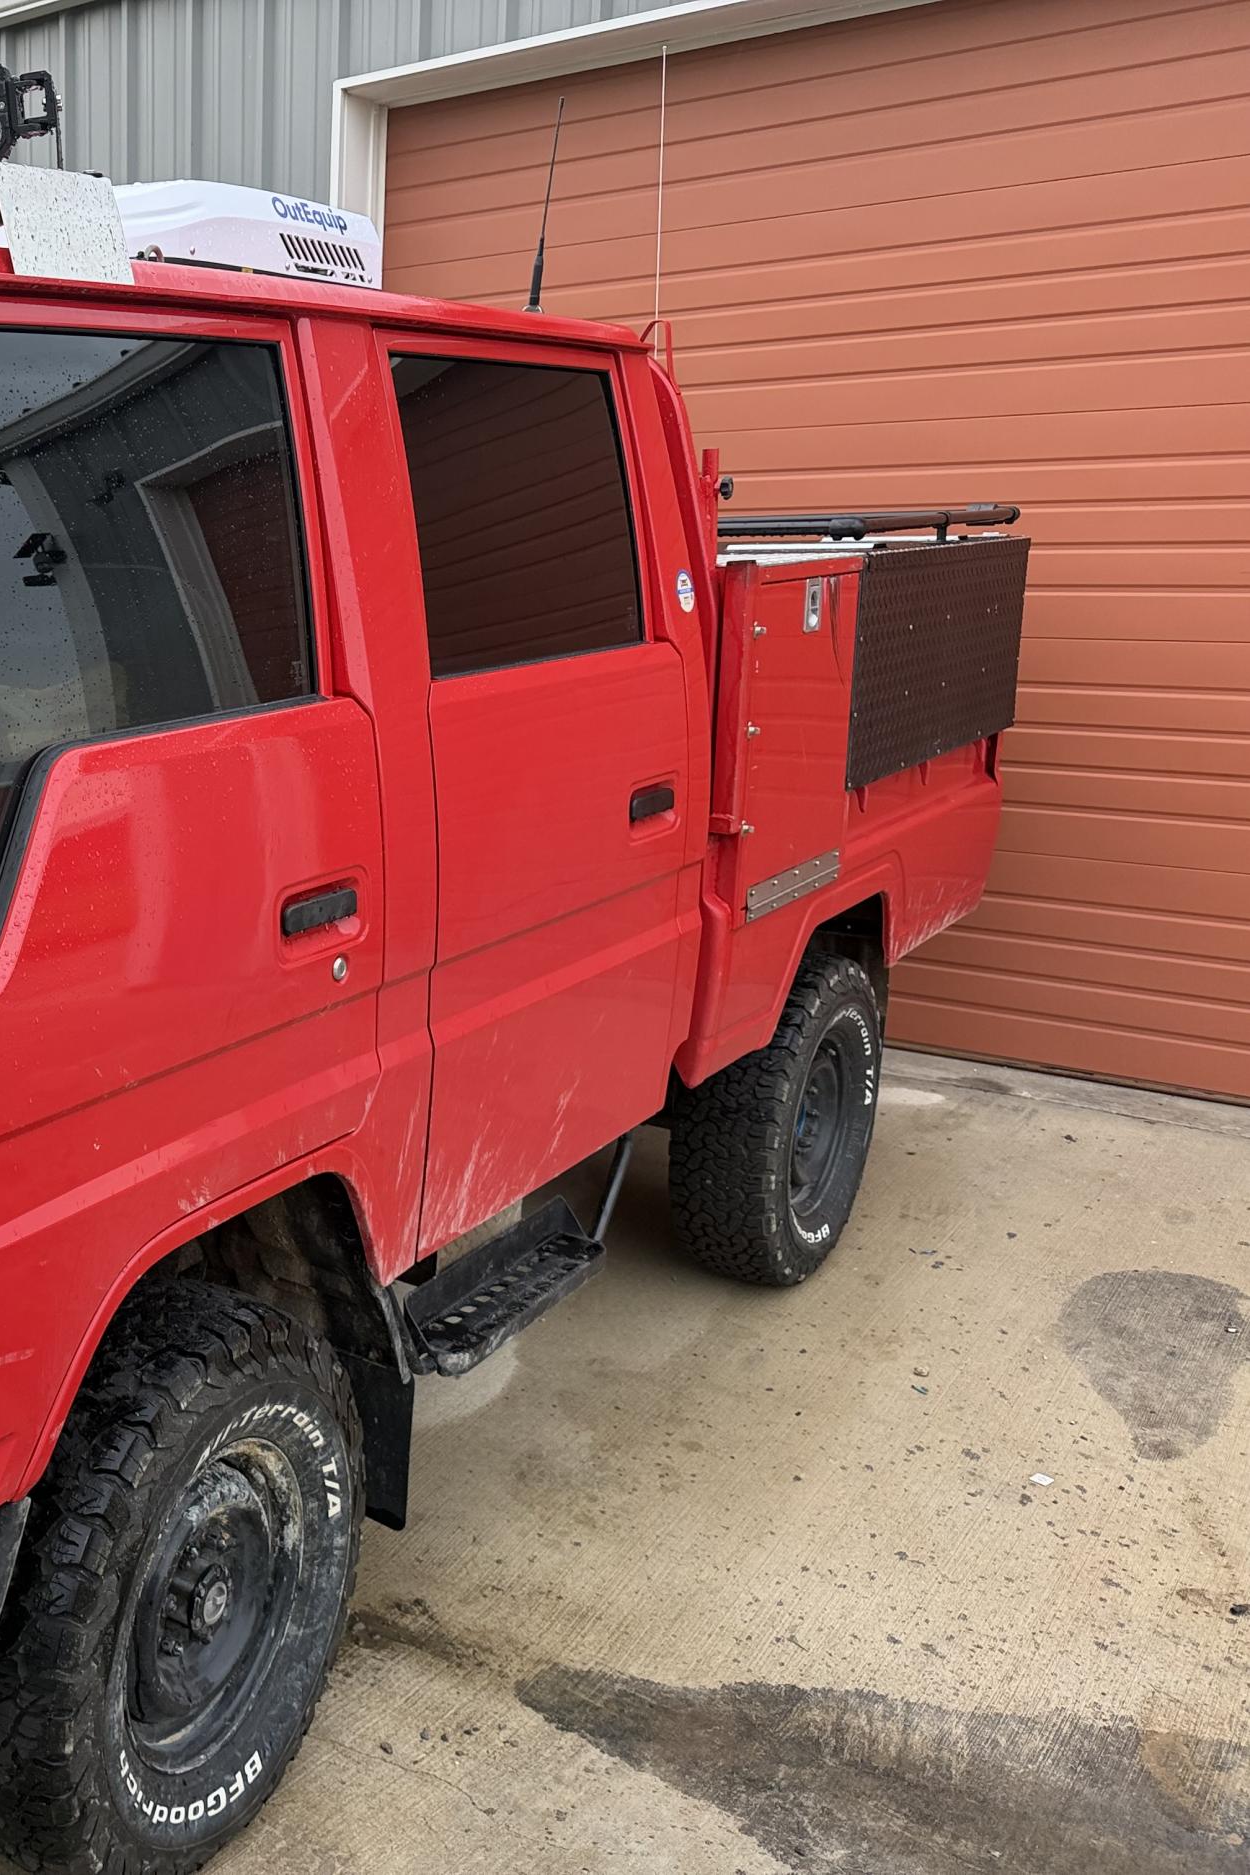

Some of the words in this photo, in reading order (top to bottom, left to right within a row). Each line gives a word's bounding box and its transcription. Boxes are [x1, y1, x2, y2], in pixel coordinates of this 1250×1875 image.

[272, 196, 347, 235] OutEquip
[864, 1065, 874, 1106] T/A
[193, 1404, 325, 1475] All-Terrain
[322, 1456, 342, 1519] T/A
[119, 1750, 263, 1824] BFGoodrich
